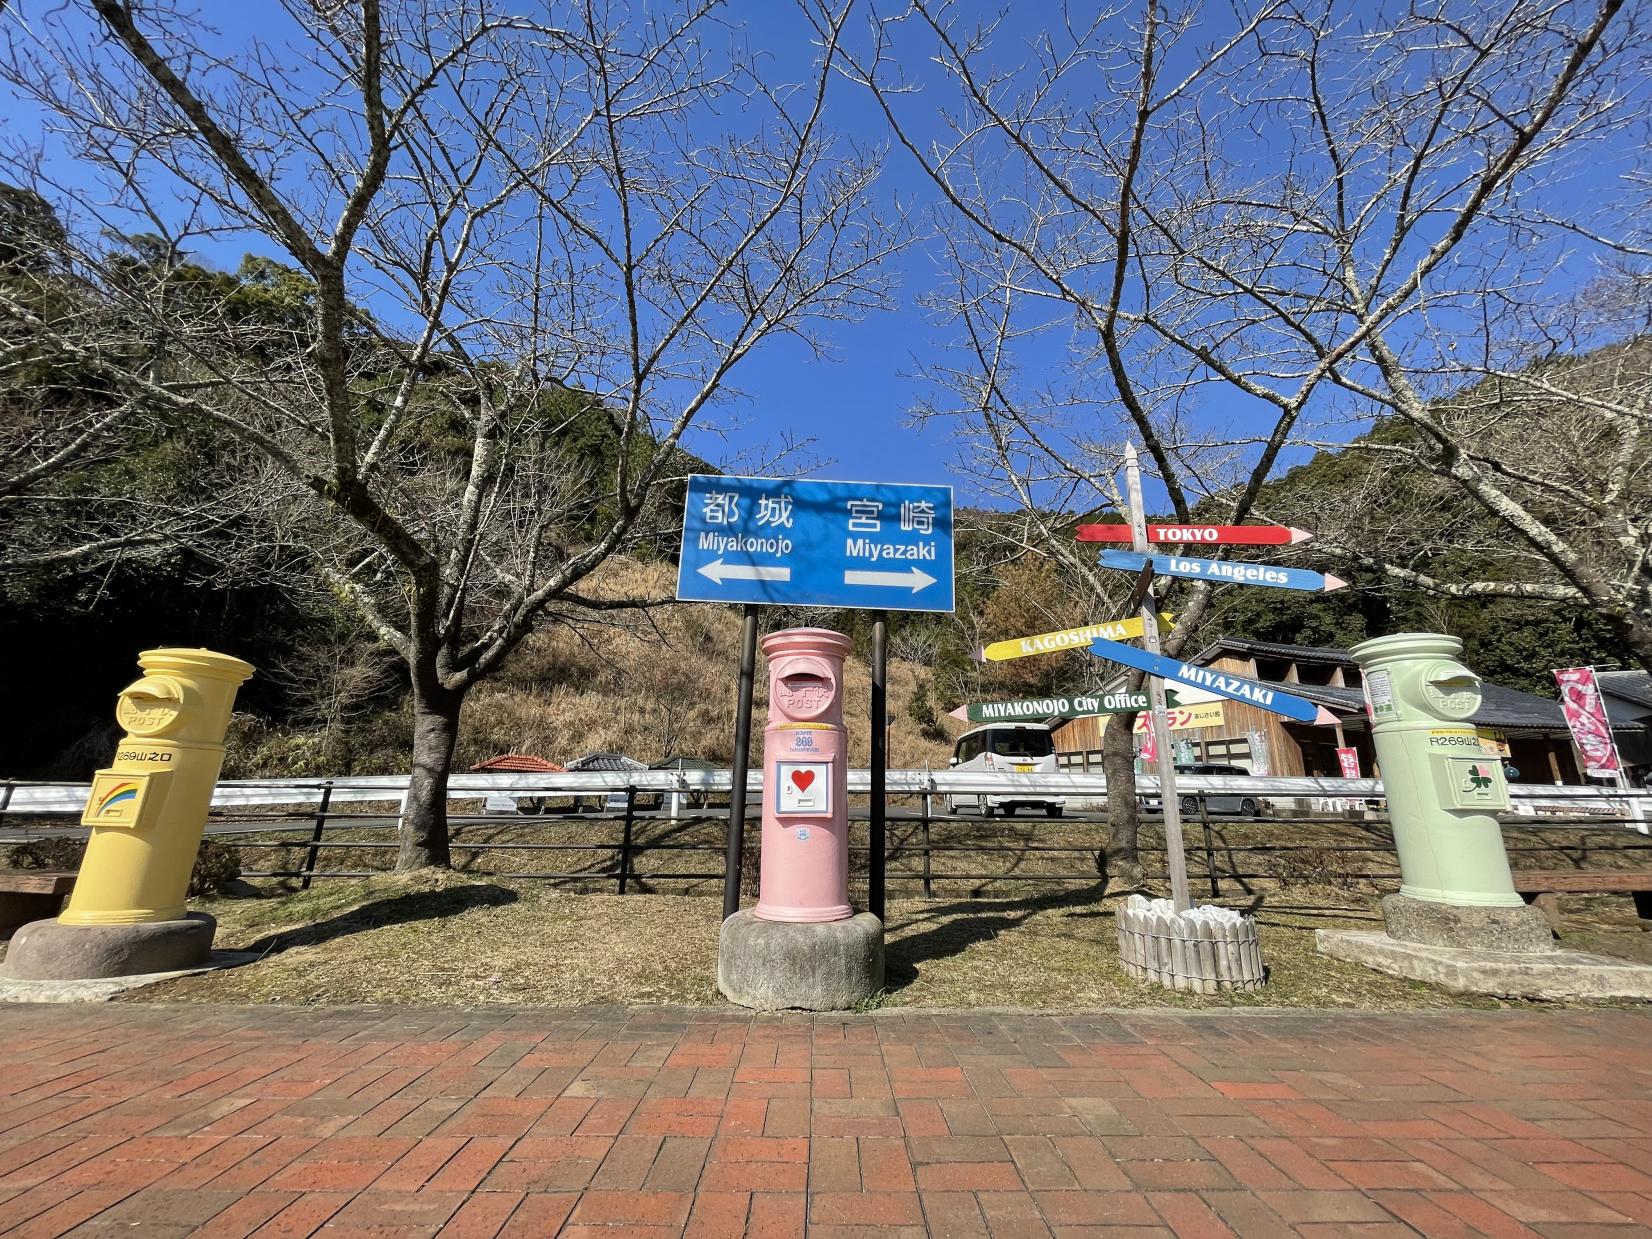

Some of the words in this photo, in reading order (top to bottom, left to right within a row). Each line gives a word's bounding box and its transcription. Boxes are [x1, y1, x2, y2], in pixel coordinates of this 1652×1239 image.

[703, 490, 793, 528] 都城
[847, 499, 936, 535] 宮崎
[699, 532, 793, 557] Miyakonojo
[1156, 528, 1219, 541] TOKYO
[846, 538, 936, 562] Miyazaki
[1170, 559, 1201, 574] Los
[1207, 562, 1288, 584] Angeles
[1020, 623, 1127, 653] KAGOSHIMA
[1178, 664, 1275, 706] MIYAZAKI
[786, 698, 822, 708] POST
[982, 697, 1069, 718] MIYAKONOJO
[1073, 696, 1100, 714] City
[1104, 692, 1148, 709] Office
[1439, 699, 1472, 710] POST
[128, 716, 164, 726] POST
[1135, 709, 1193, 729] スラン
